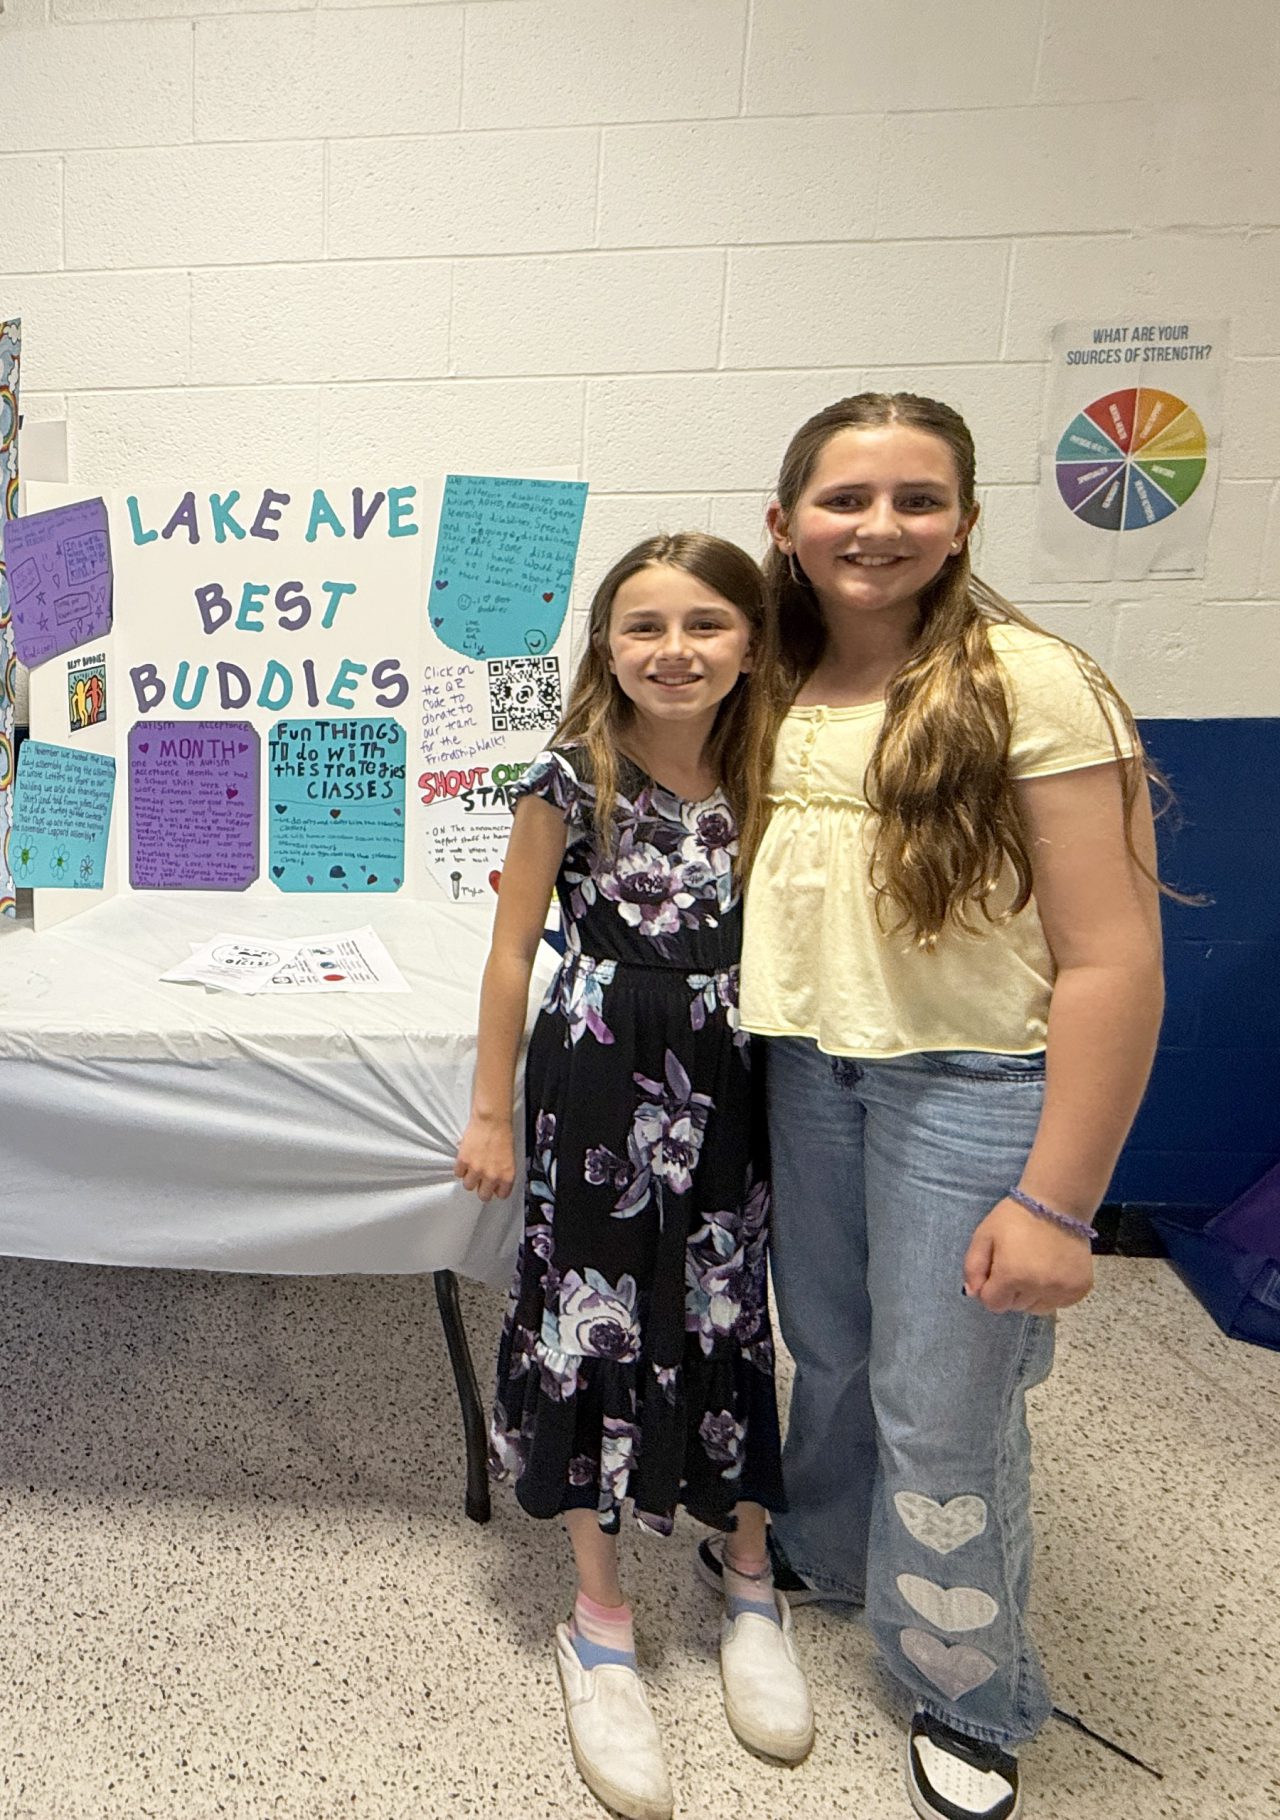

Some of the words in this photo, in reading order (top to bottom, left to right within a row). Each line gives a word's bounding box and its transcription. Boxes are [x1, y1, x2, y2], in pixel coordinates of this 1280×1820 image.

[1093, 327, 1129, 343] WHAT
[1131, 326, 1156, 342] ARE
[1159, 325, 1189, 341] YOUR
[1066, 348, 1121, 365] SOURCES
[1124, 347, 1141, 363] OF
[1142, 344, 1213, 362] STRENGTH?
[126, 488, 291, 546] LAKE
[304, 485, 419, 543] AVE
[194, 580, 358, 635] BEST
[424, 666, 454, 680] Click
[458, 665, 475, 676] on
[129, 658, 410, 714] BUDDIES
[421, 685, 440, 696] the
[446, 677, 466, 692] QR
[421, 707, 457, 726] donate
[458, 703, 473, 714] to
[277, 722, 312, 741] Fun
[424, 725, 440, 739] our
[445, 717, 477, 730] team
[160, 738, 236, 760] MONTH
[296, 742, 319, 761] do
[420, 740, 434, 753] for
[440, 735, 462, 745] the
[417, 766, 490, 804] SHOUT
